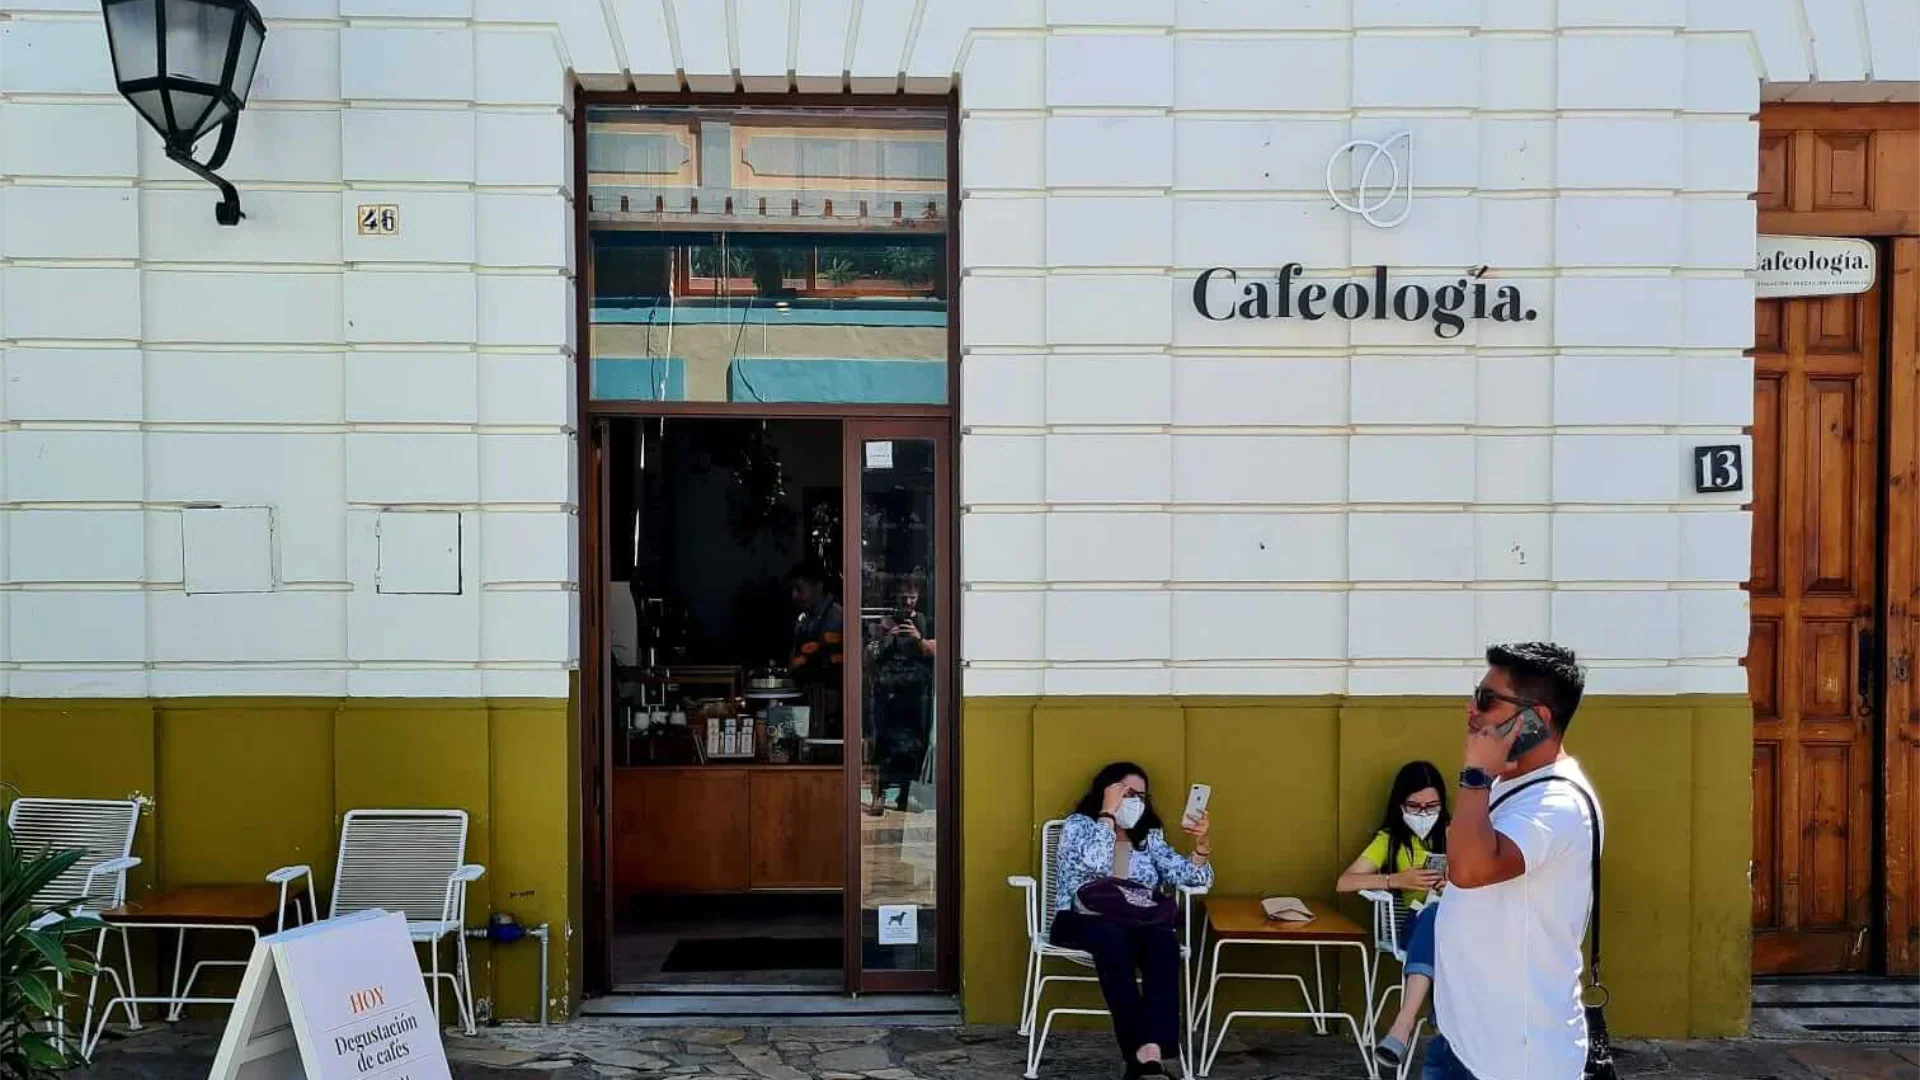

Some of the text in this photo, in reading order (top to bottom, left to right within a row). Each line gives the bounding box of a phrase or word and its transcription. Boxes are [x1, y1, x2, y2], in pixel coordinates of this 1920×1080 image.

[362, 208, 394, 231] 46
[1757, 250, 1869, 275] afeología.
[1193, 262, 1537, 339] Cafeología.
[1700, 450, 1738, 488] 13
[349, 985, 384, 1014] HOY
[335, 1012, 418, 1056] Degustación
[357, 1038, 410, 1073] de cafés
